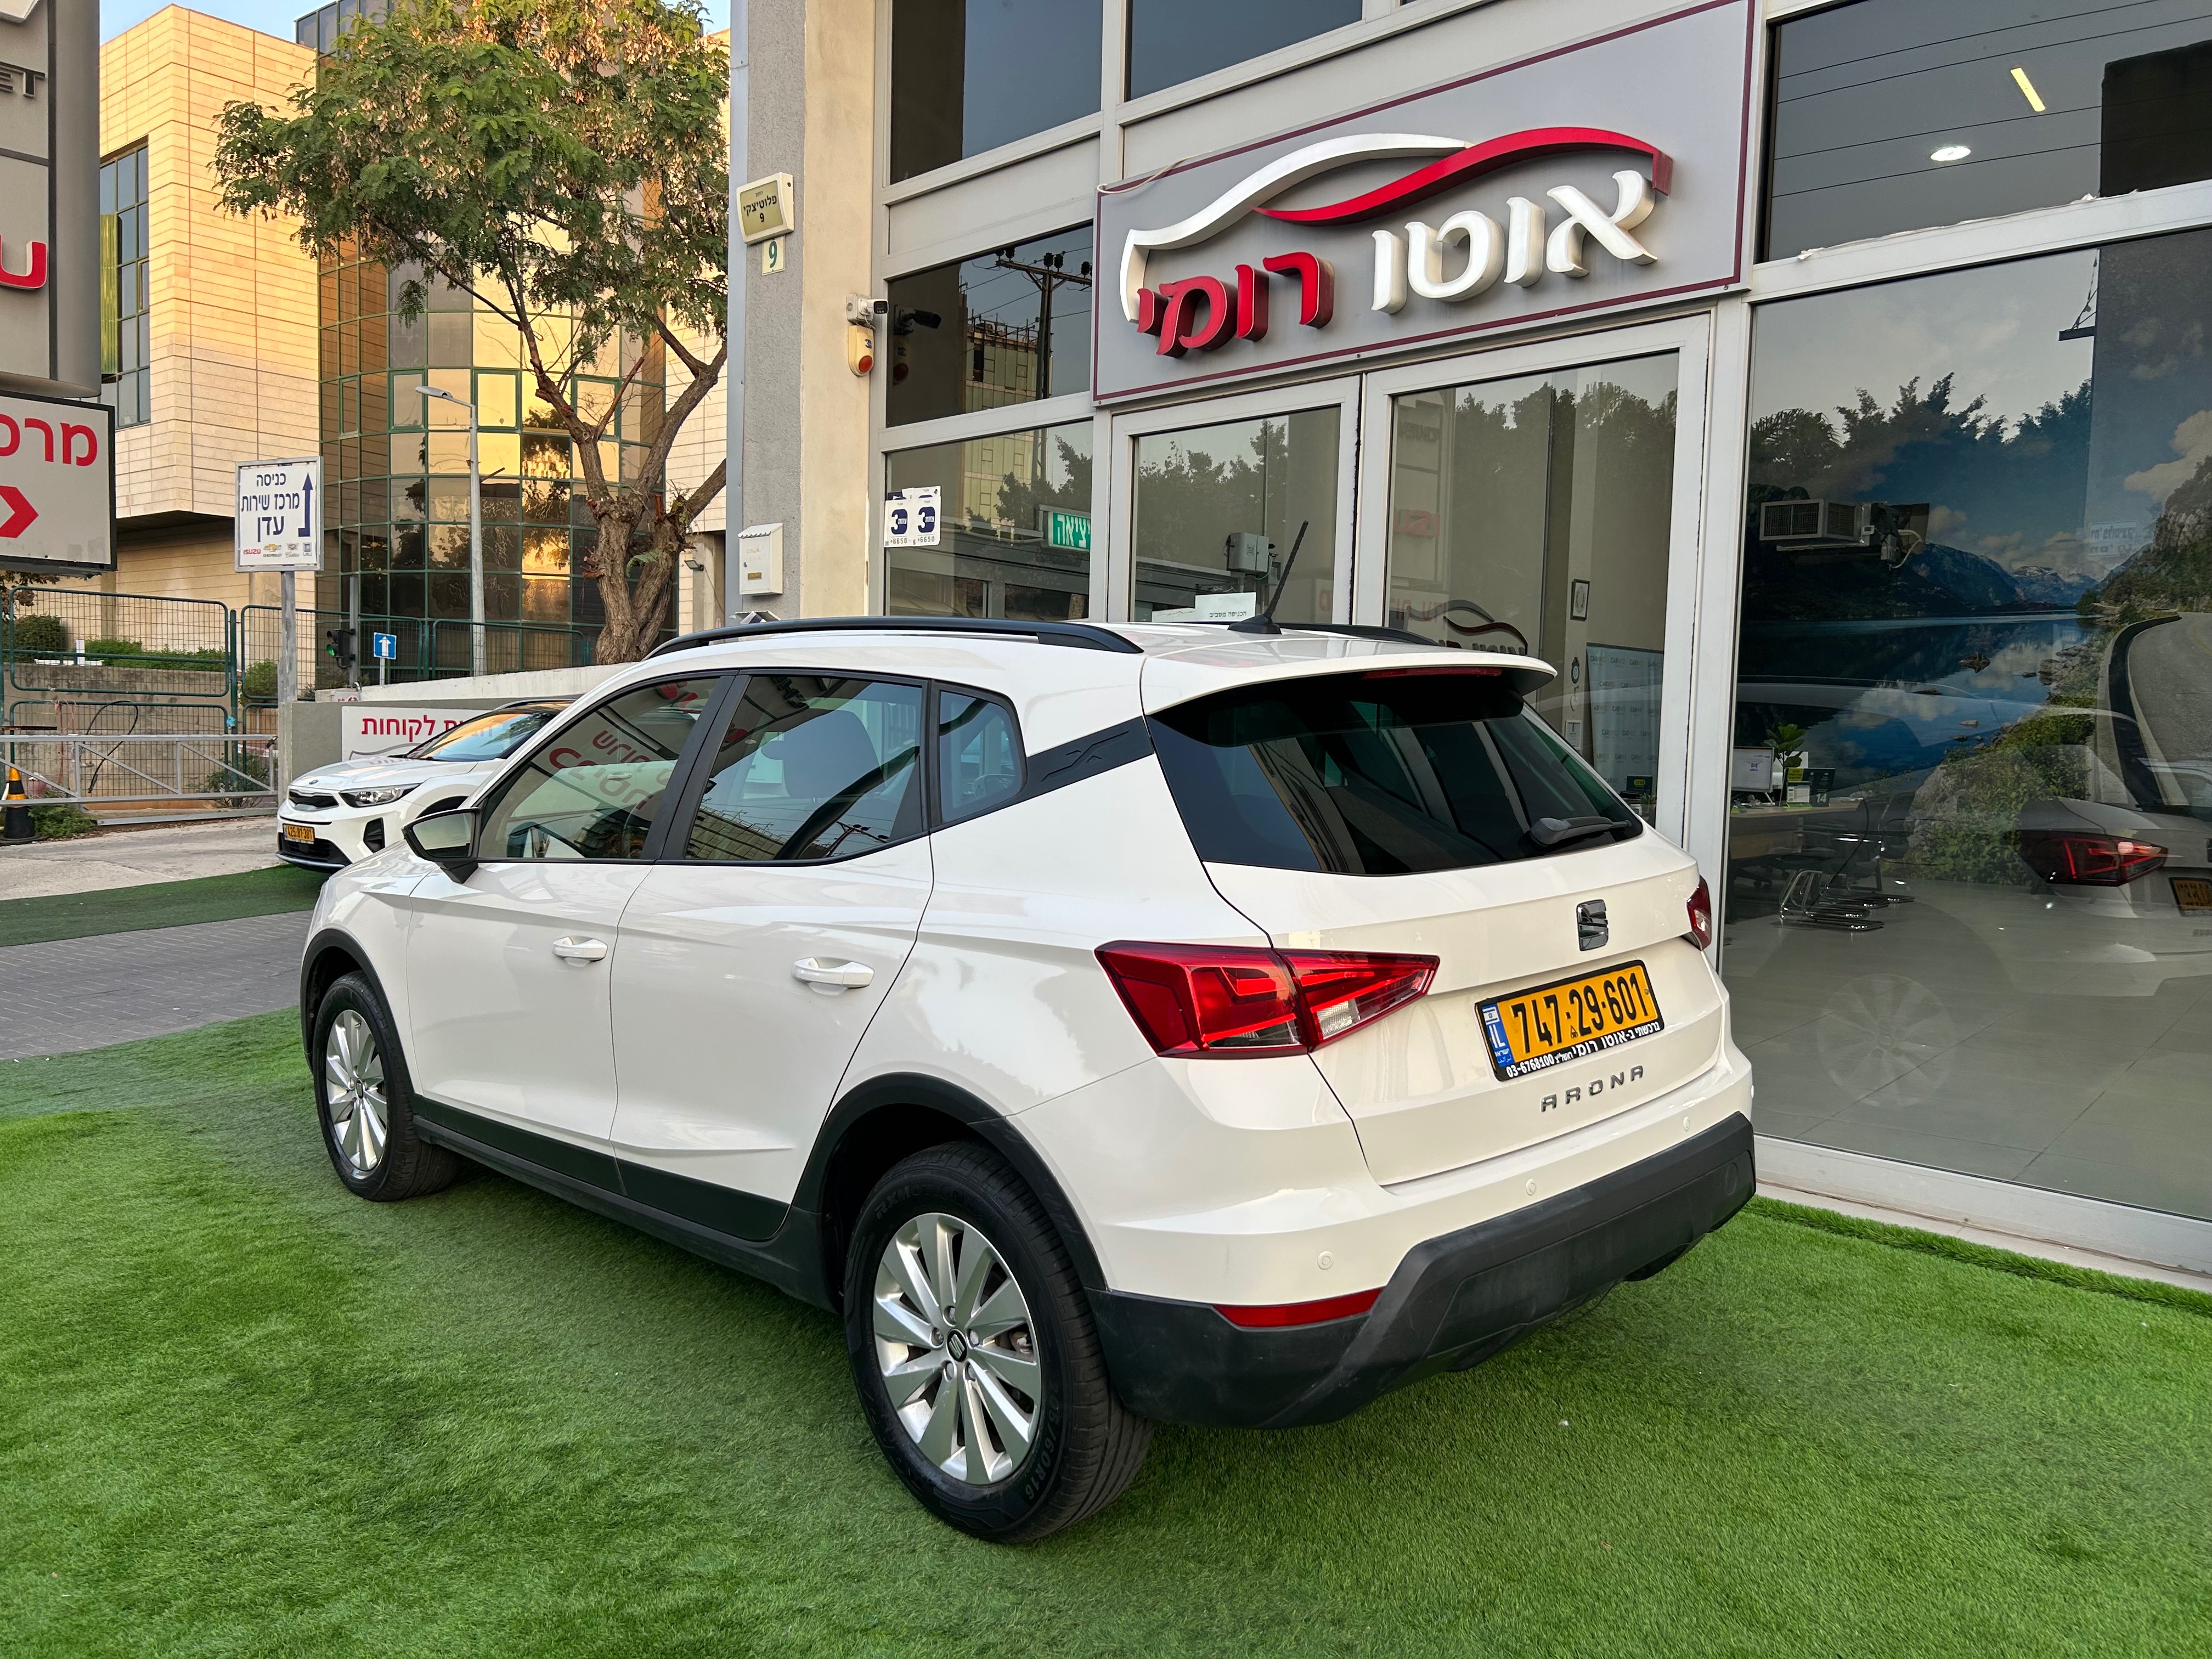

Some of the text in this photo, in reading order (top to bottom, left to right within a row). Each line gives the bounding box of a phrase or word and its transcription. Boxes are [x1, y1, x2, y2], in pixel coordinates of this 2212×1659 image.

[743, 195, 777, 217] פלוטיצקי
[759, 213, 765, 222] 9
[768, 240, 778, 268] 9
[1136, 170, 1658, 358] אוטו רומי
[256, 473, 286, 487] כניסה
[241, 493, 300, 512] מרכז שירות
[257, 516, 285, 543] עדן
[362, 714, 436, 742] לקוחות
[1816, 793, 1827, 803] 14
[1488, 1024, 1506, 1049] IL
[1600, 1030, 1635, 1048] ב-אוטו
[1634, 1021, 1661, 1036] נרכשתי
[1571, 1040, 1599, 1057] רומי
[1506, 1053, 1555, 1078] 03-6768100
[1540, 1064, 1644, 1113] ARONA
[1025, 1380, 1059, 1500] 205/60R16
